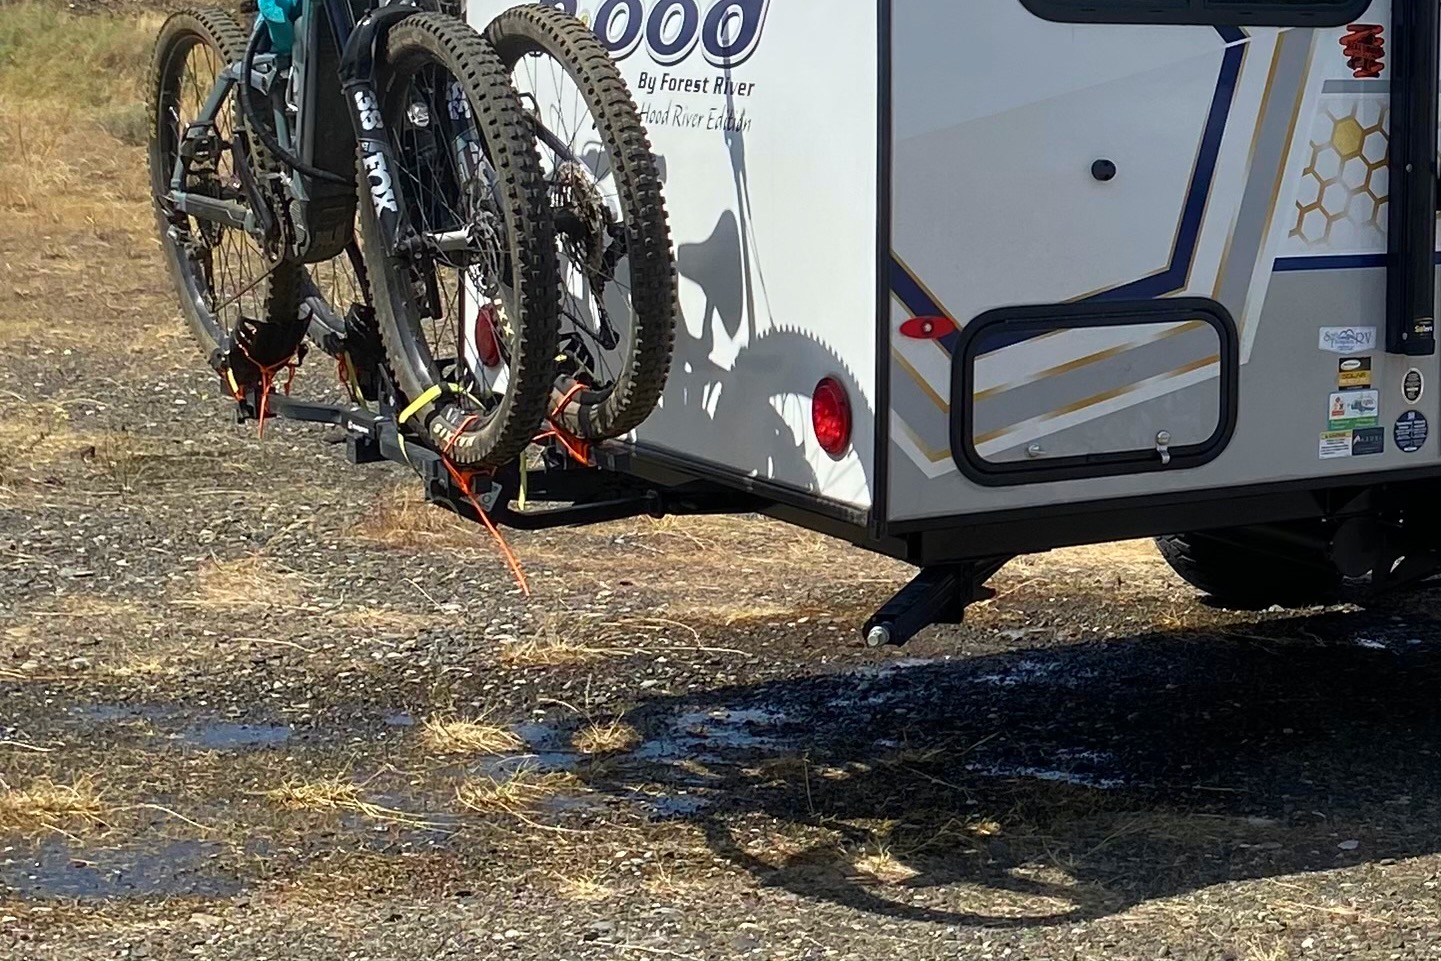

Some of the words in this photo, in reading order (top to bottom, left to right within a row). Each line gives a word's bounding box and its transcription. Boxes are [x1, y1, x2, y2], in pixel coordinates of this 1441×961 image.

[637, 71, 654, 95] By
[659, 72, 709, 94] Forest
[713, 76, 756, 97] River
[640, 100, 670, 127] Hood
[672, 105, 703, 130] River
[706, 107, 752, 132] Edition
[362, 151, 398, 218] FOX
